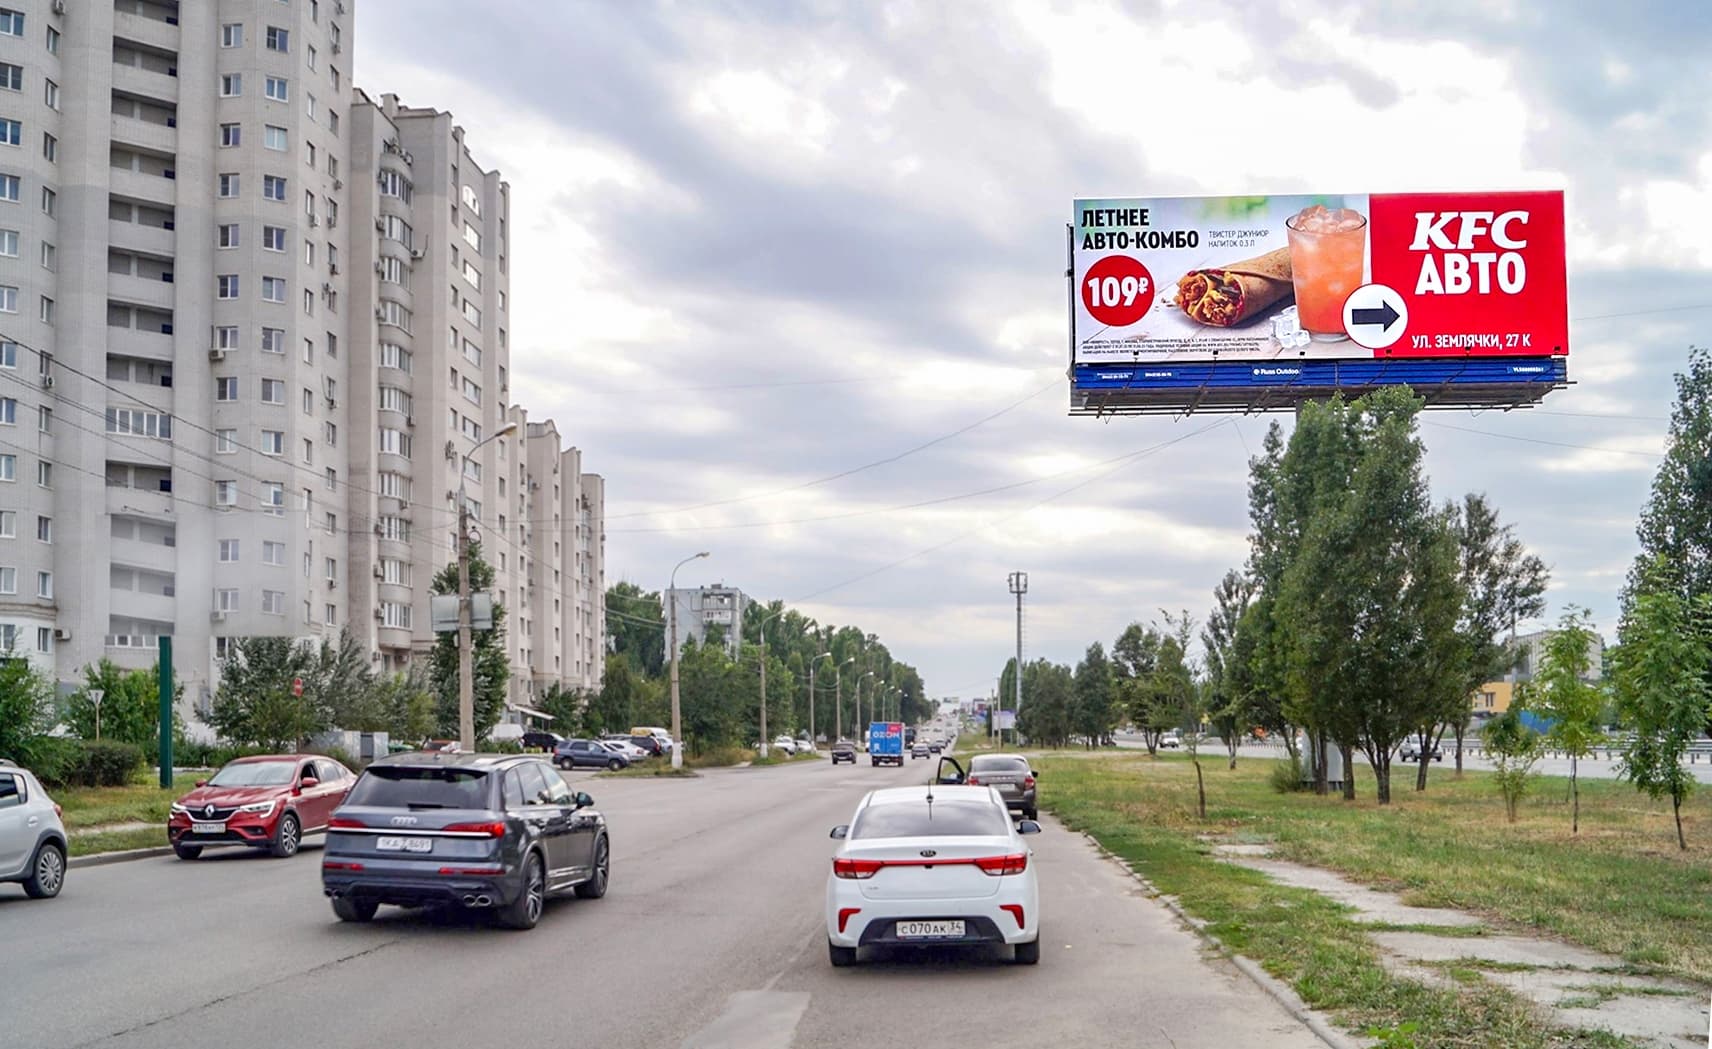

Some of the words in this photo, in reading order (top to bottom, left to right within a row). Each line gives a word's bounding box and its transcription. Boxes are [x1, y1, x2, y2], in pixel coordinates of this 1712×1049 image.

[1081, 209, 1149, 227] ЛЕТНЕЕ
[1208, 230, 1236, 239] ТВИСТЕР
[1237, 229, 1270, 239] ДЖУНИОР
[1409, 210, 1529, 250] KFC
[1082, 230, 1199, 250] АВТО-КОМБО
[1208, 239, 1239, 248] НАПИТОК
[1414, 251, 1526, 295] АВТО
[1412, 335, 1432, 348] УЛ.
[1434, 334, 1503, 350] ЗЕМЛЯЧКИ,
[1505, 333, 1519, 347] 27
[1522, 333, 1531, 346] К
